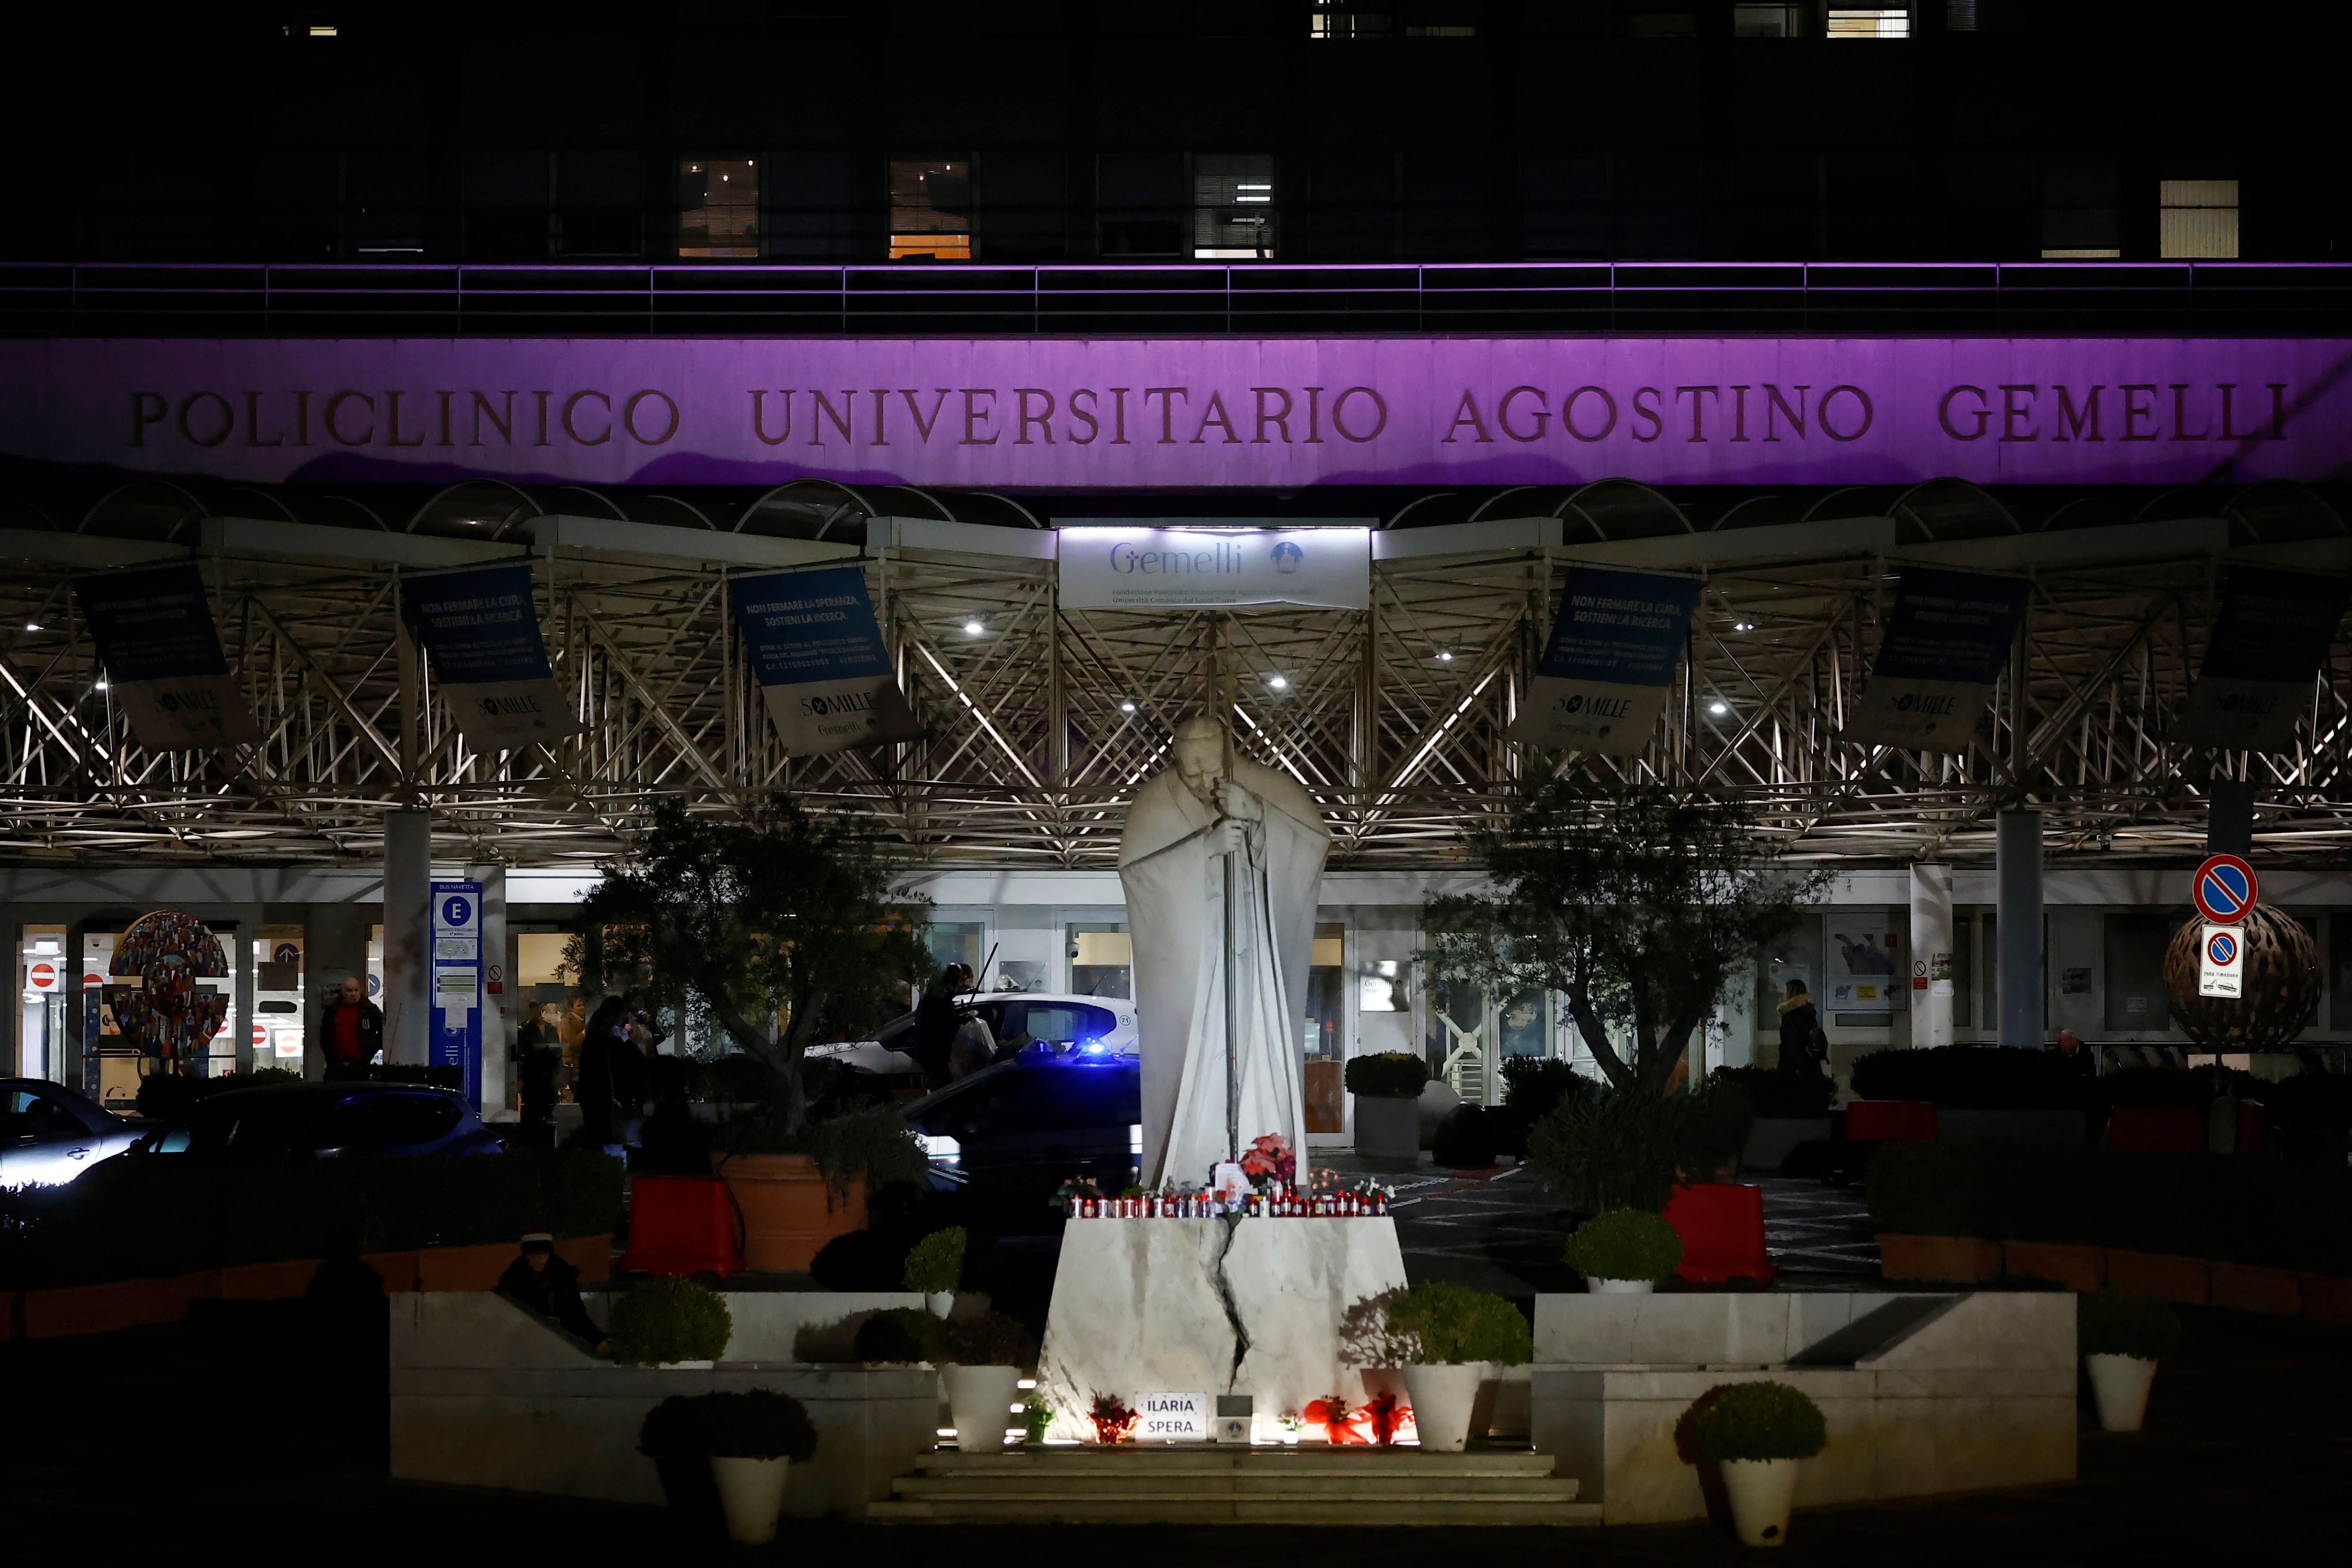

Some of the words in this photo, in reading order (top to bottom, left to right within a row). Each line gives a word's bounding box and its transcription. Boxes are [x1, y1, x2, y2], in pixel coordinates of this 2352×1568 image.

[128, 388, 681, 447] POLICLINICO
[747, 386, 1388, 446] UNIVERSITARIO
[1442, 385, 1874, 443] AGOSTINO
[1938, 383, 2290, 443] GEMELLI
[1110, 543, 1241, 574] Gemelli
[485, 597, 497, 608] LA
[746, 604, 766, 614] NON
[766, 600, 803, 612] FERMARE
[804, 599, 815, 609] LA
[1571, 596, 1596, 607] NON
[1596, 597, 1641, 611] FERMARE
[1640, 602, 1653, 612] LA
[765, 615, 801, 627] SOSTIENI
[801, 614, 813, 623] LA
[1573, 610, 1616, 624] SOSTIENI
[818, 721, 861, 736] Gemelli
[452, 903, 461, 919] E
[1148, 1400, 1194, 1412] ILARIA
[1148, 1421, 1193, 1433] SPERA
